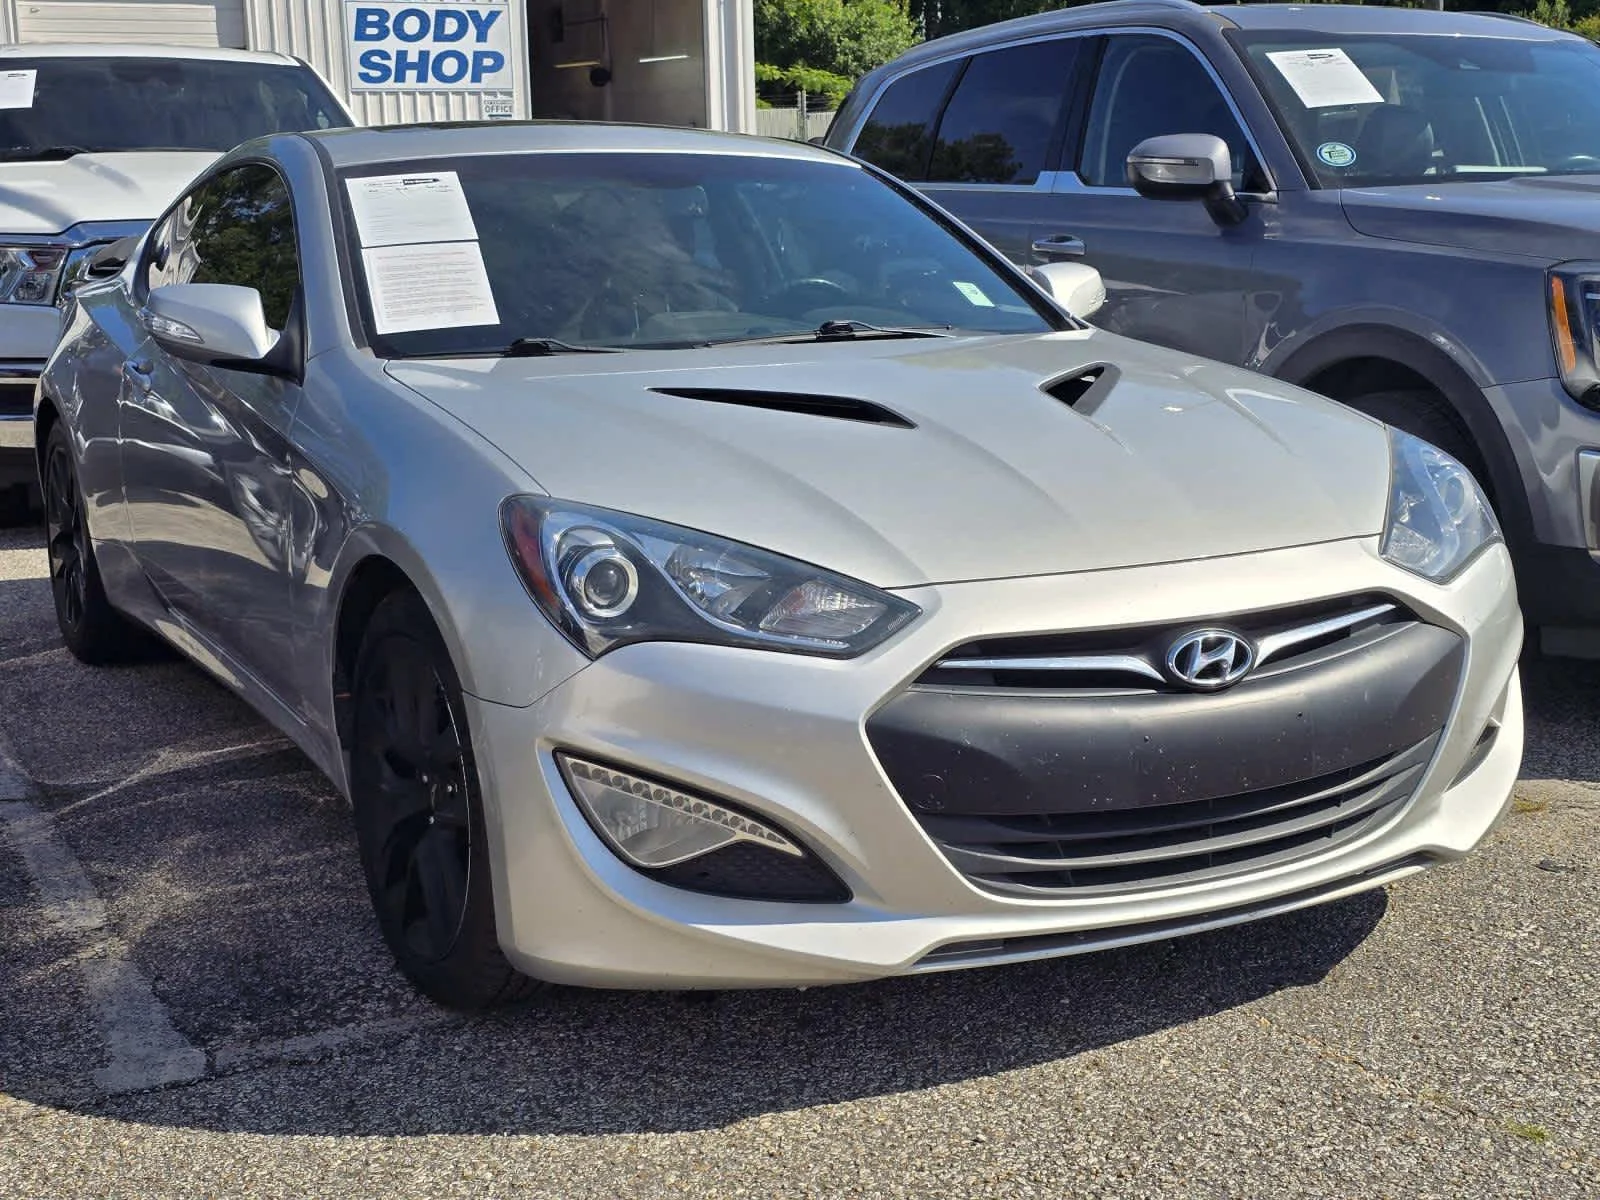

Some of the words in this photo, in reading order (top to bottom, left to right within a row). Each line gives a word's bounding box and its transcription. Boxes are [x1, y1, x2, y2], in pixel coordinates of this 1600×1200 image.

[354, 8, 502, 42] BODY
[358, 49, 505, 84] SHOP
[484, 104, 513, 113] OFFICE
